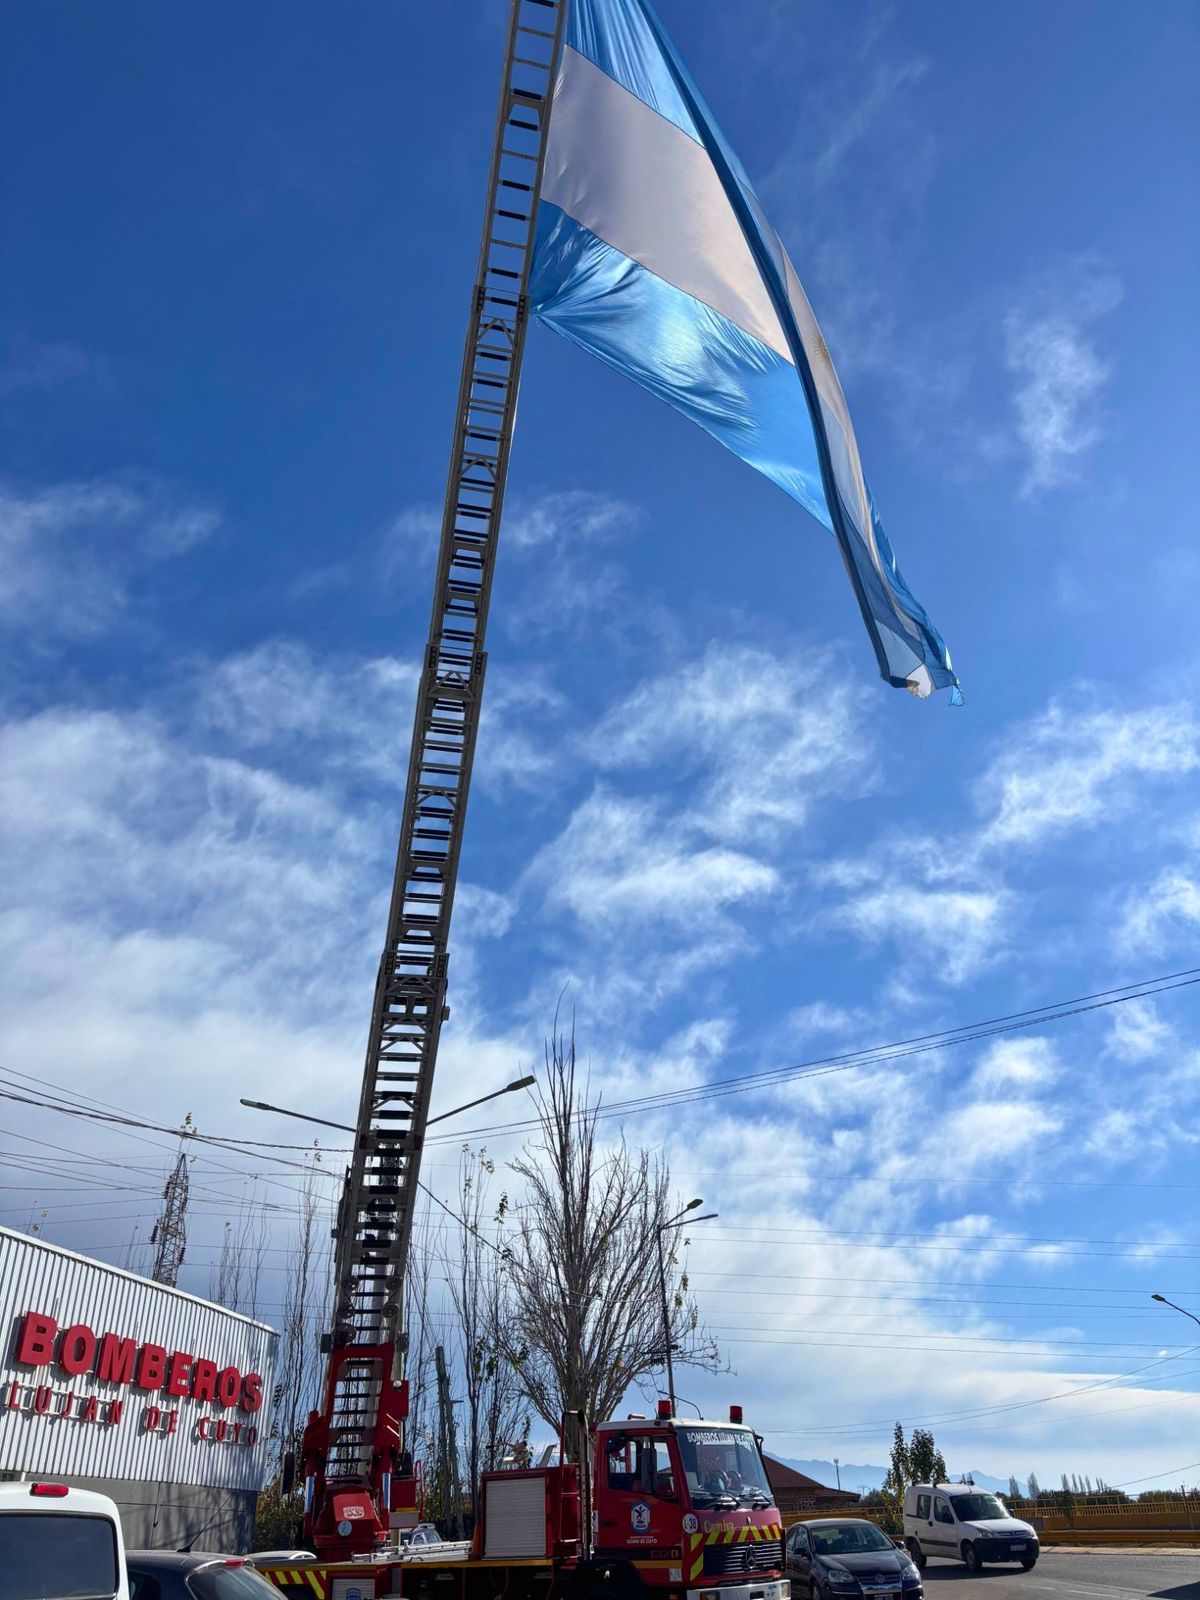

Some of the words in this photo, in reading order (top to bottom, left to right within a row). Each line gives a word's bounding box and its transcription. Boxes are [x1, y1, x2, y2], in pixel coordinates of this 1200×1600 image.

[17, 1311, 262, 1413] BOMBEROS
[8, 1381, 123, 1425] LUJAN
[147, 1406, 179, 1434] DE
[199, 1416, 257, 1446] CUYO
[687, 1432, 718, 1443] BOMBEROS
